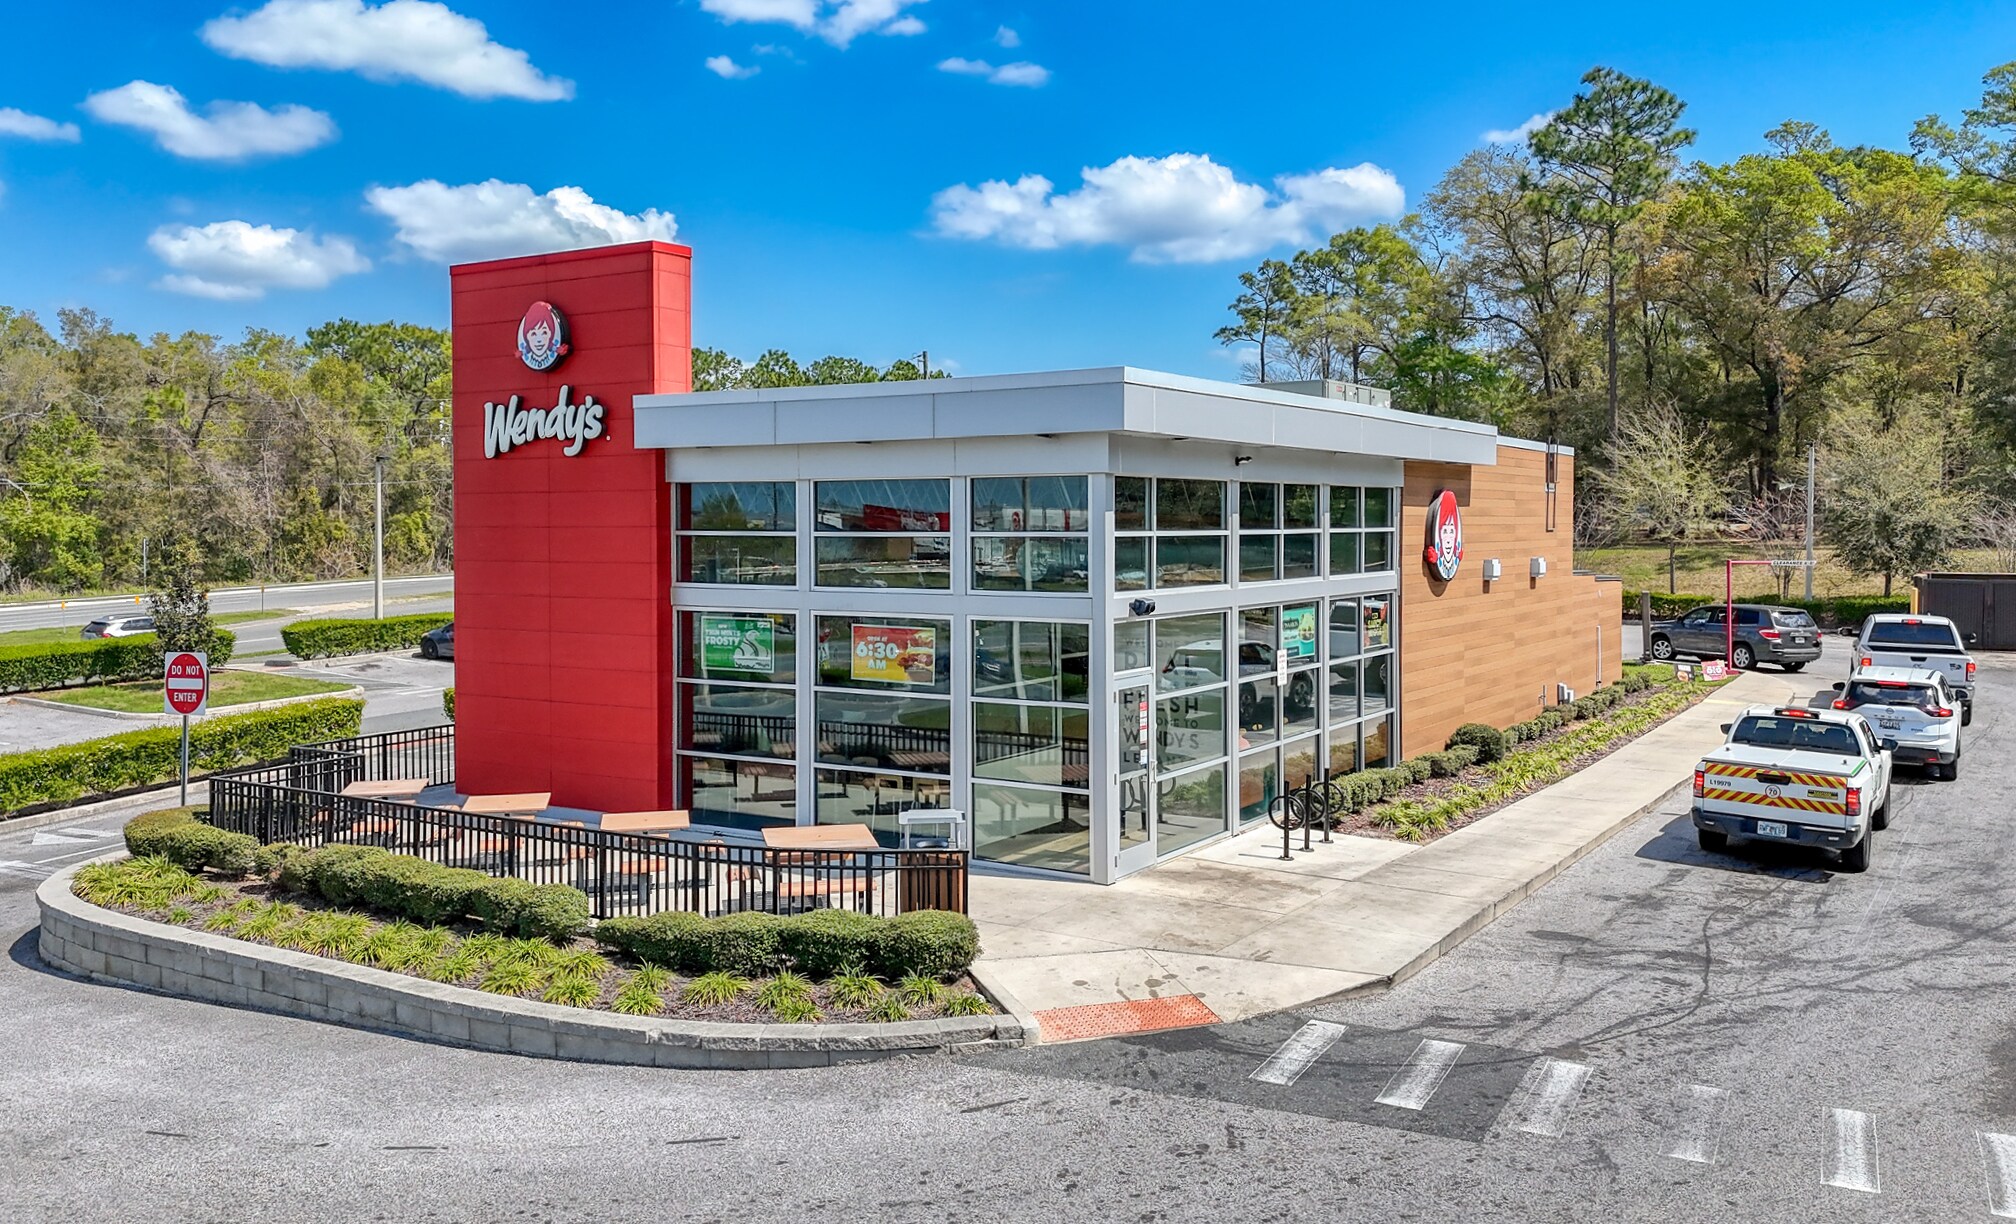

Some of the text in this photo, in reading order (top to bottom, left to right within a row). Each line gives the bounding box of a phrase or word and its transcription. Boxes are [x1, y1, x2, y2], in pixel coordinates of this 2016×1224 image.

[484, 384, 604, 459] Wendy's
[705, 636, 741, 646] FROSTY
[856, 641, 899, 660] 6:30
[171, 665, 200, 675] DO NOT
[867, 659, 887, 670] AM
[173, 692, 197, 702] ENTER
[1123, 691, 1199, 714] FSH
[1124, 714, 1180, 728] WEOME
